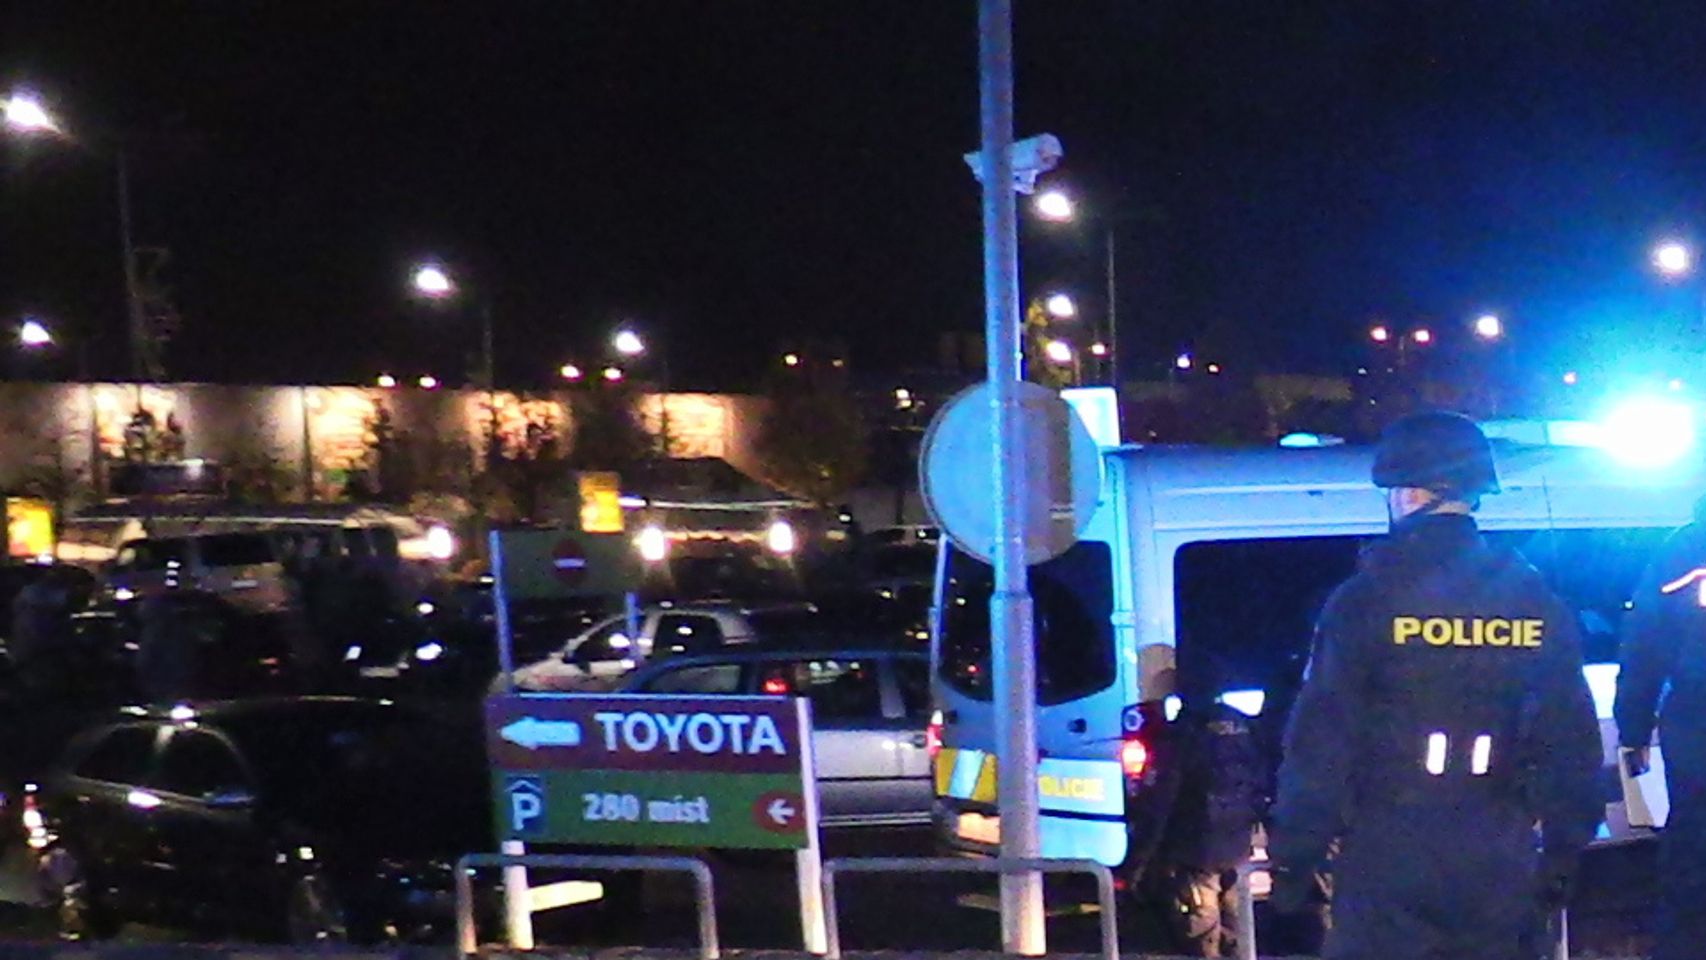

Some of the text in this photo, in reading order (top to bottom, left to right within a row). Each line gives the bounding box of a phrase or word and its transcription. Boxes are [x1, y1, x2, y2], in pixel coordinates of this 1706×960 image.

[1394, 616, 1545, 647] POLICIE
[594, 711, 787, 755] TOYOTA
[512, 792, 541, 831] P
[583, 793, 640, 821] 280
